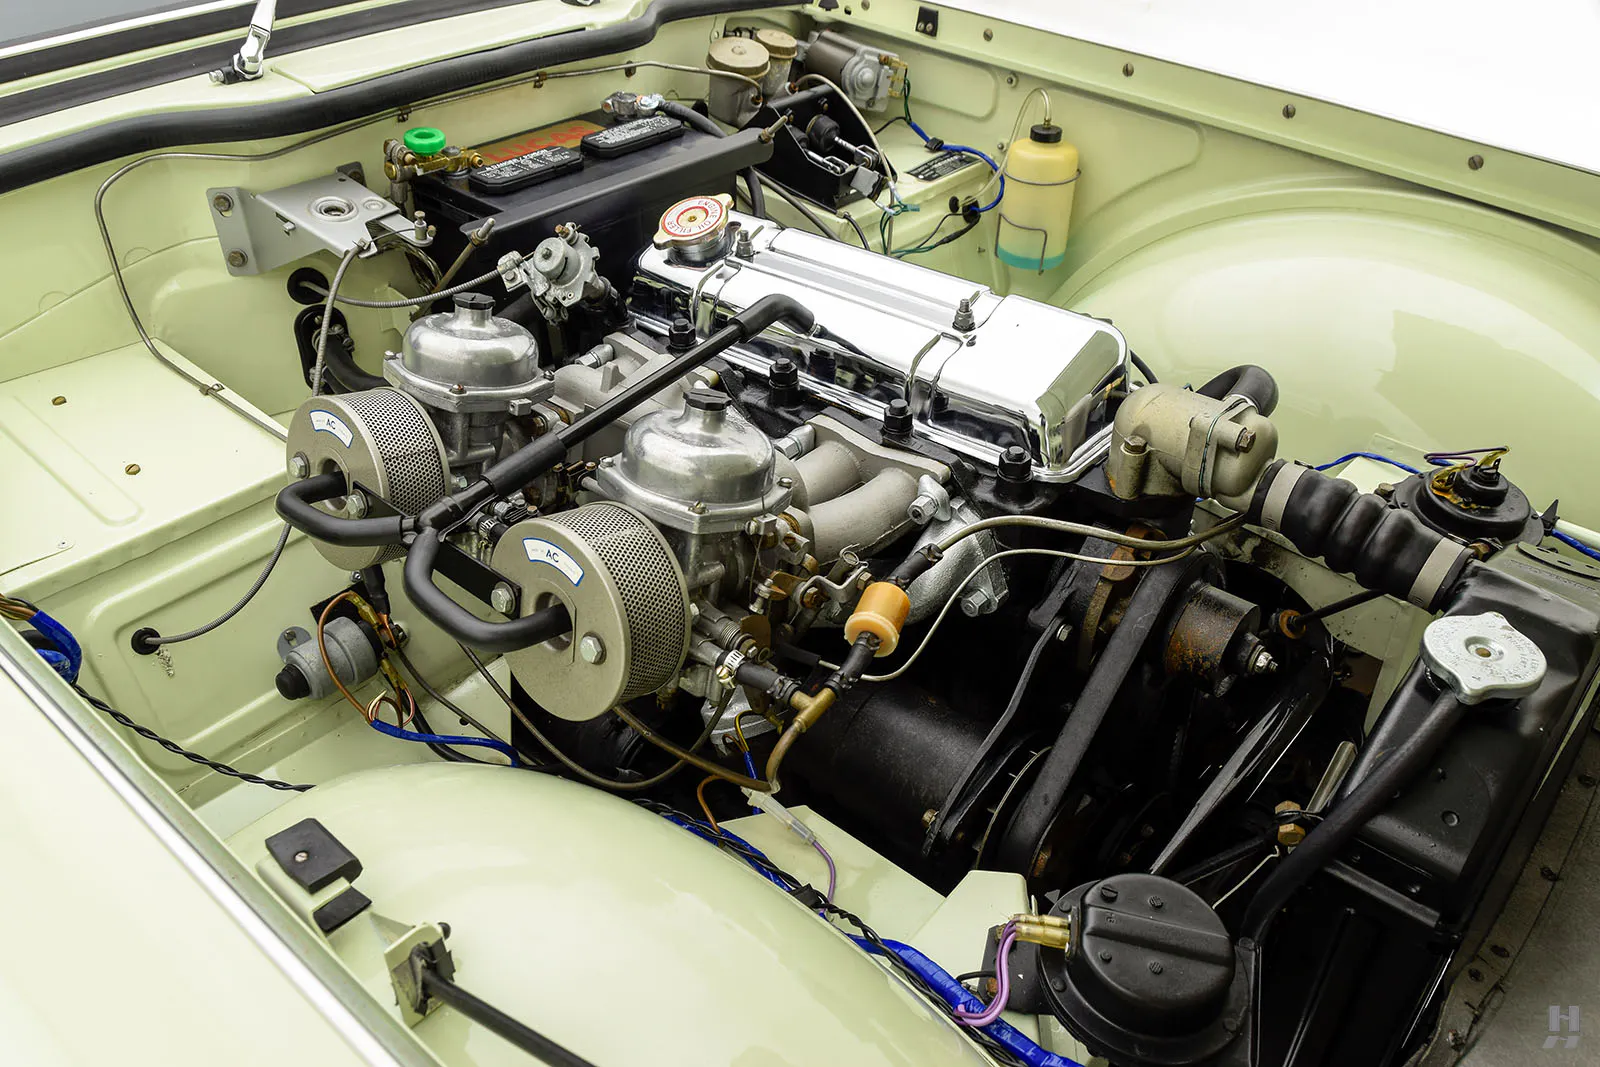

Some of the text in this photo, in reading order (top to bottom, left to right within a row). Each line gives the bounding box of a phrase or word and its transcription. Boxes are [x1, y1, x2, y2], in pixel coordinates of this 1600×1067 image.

[484, 125, 596, 162] LUCAS
[698, 200, 718, 218] ENGINE
[697, 220, 711, 231] OIL
[325, 418, 337, 430] AC
[545, 549, 560, 563] AC
